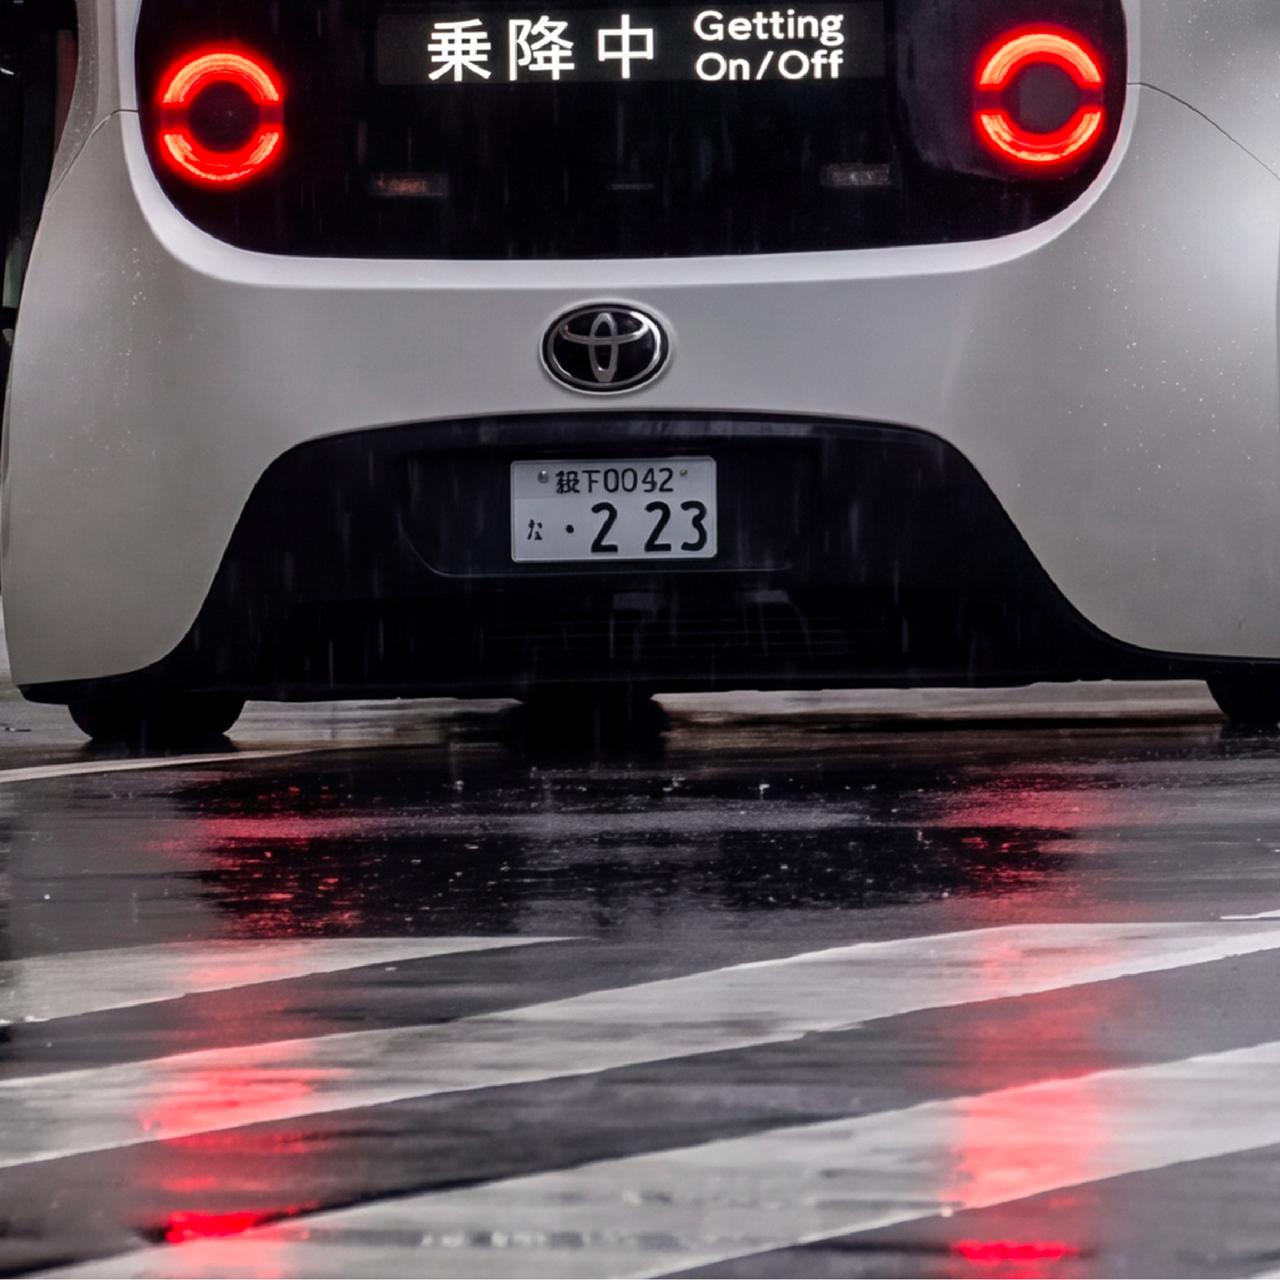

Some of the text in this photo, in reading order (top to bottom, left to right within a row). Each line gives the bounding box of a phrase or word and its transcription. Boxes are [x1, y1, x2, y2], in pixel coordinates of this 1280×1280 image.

[693, 8, 845, 47] Getting
[426, 13, 655, 82] 乗降中
[695, 48, 844, 82] On/Off
